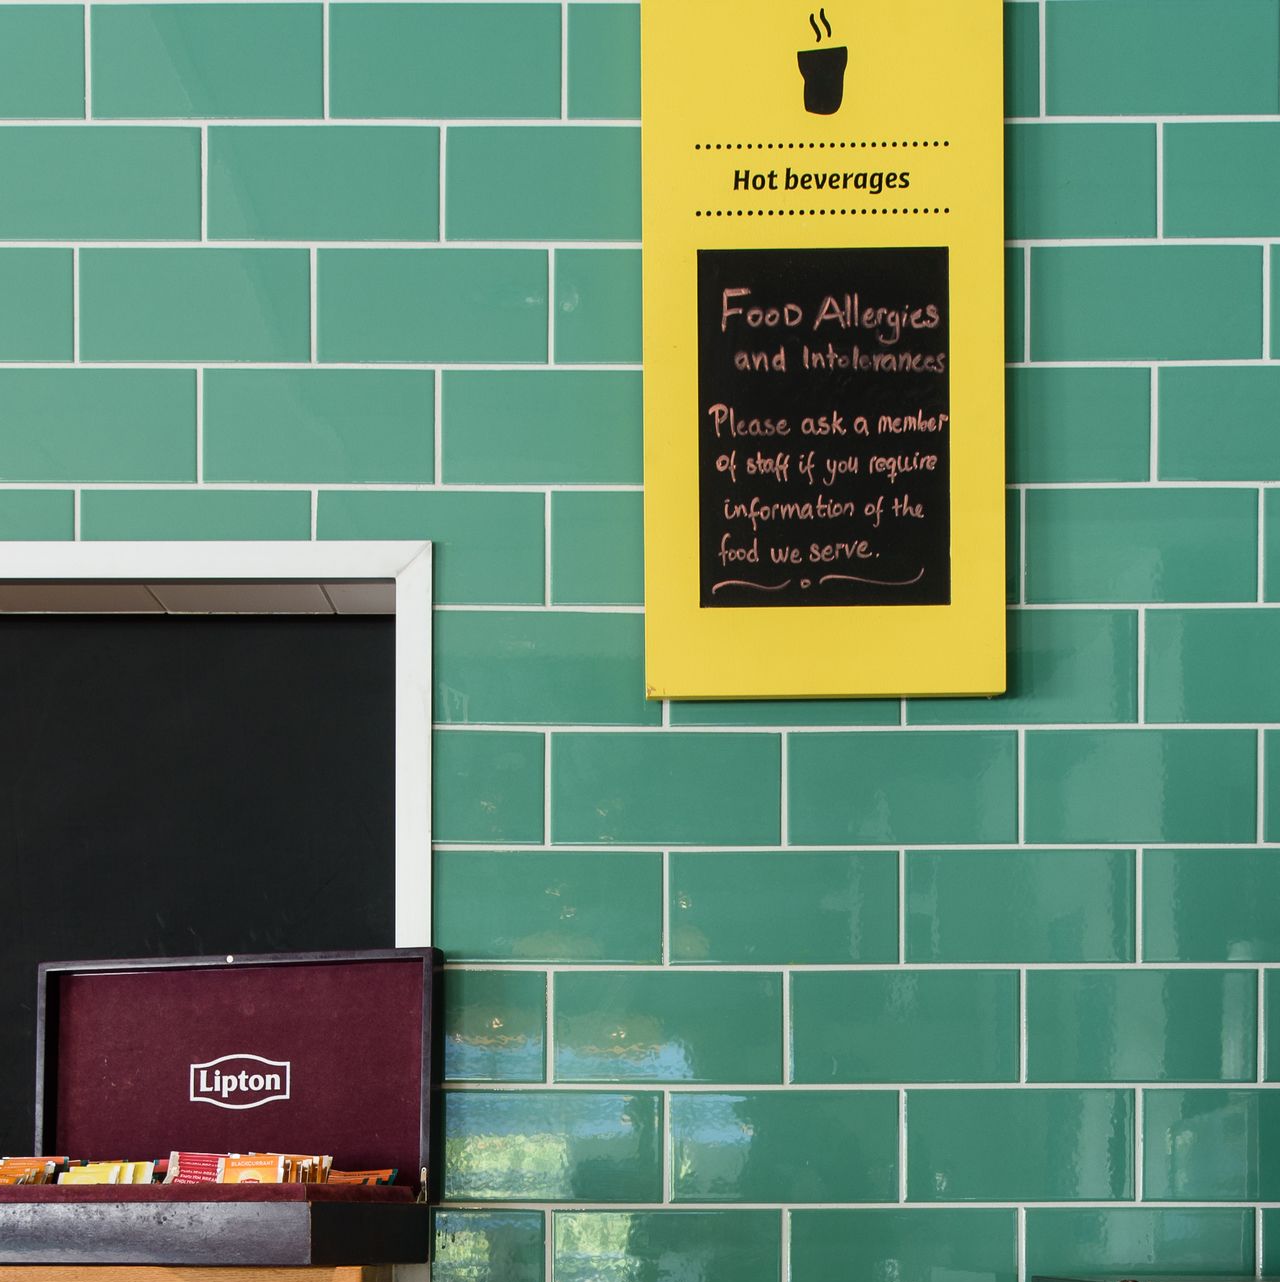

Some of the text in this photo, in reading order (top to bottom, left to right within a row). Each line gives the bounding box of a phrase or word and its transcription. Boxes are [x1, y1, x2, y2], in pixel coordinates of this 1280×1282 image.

[733, 167, 910, 194] Hot beverages
[813, 292, 940, 346] Allergies
[734, 343, 946, 374] and Intolerances
[708, 403, 949, 438] Please ask a member
[715, 450, 938, 486] of staff if you require
[724, 494, 925, 531] information of the
[718, 532, 880, 566] food we serve.
[199, 1070, 281, 1098] Lipton
